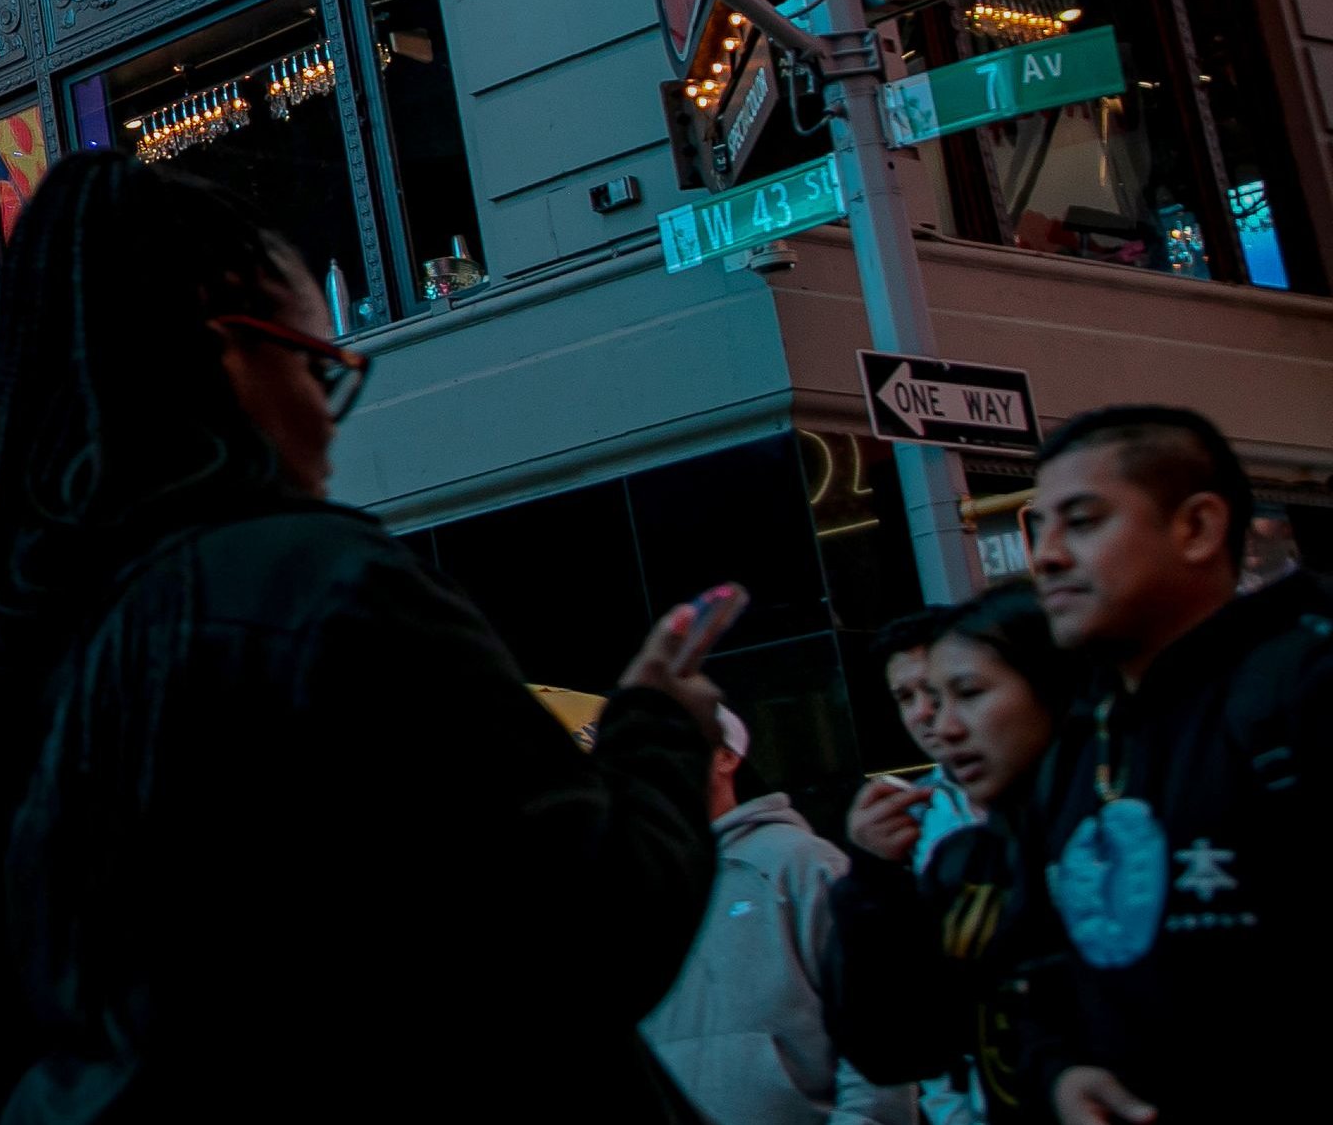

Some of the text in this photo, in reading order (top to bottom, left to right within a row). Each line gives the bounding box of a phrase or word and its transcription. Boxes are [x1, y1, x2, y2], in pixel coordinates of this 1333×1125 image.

[976, 52, 1063, 111] 7 Av
[701, 200, 734, 250] W
[752, 182, 793, 232] 43
[894, 382, 1013, 425] ONE WAY
